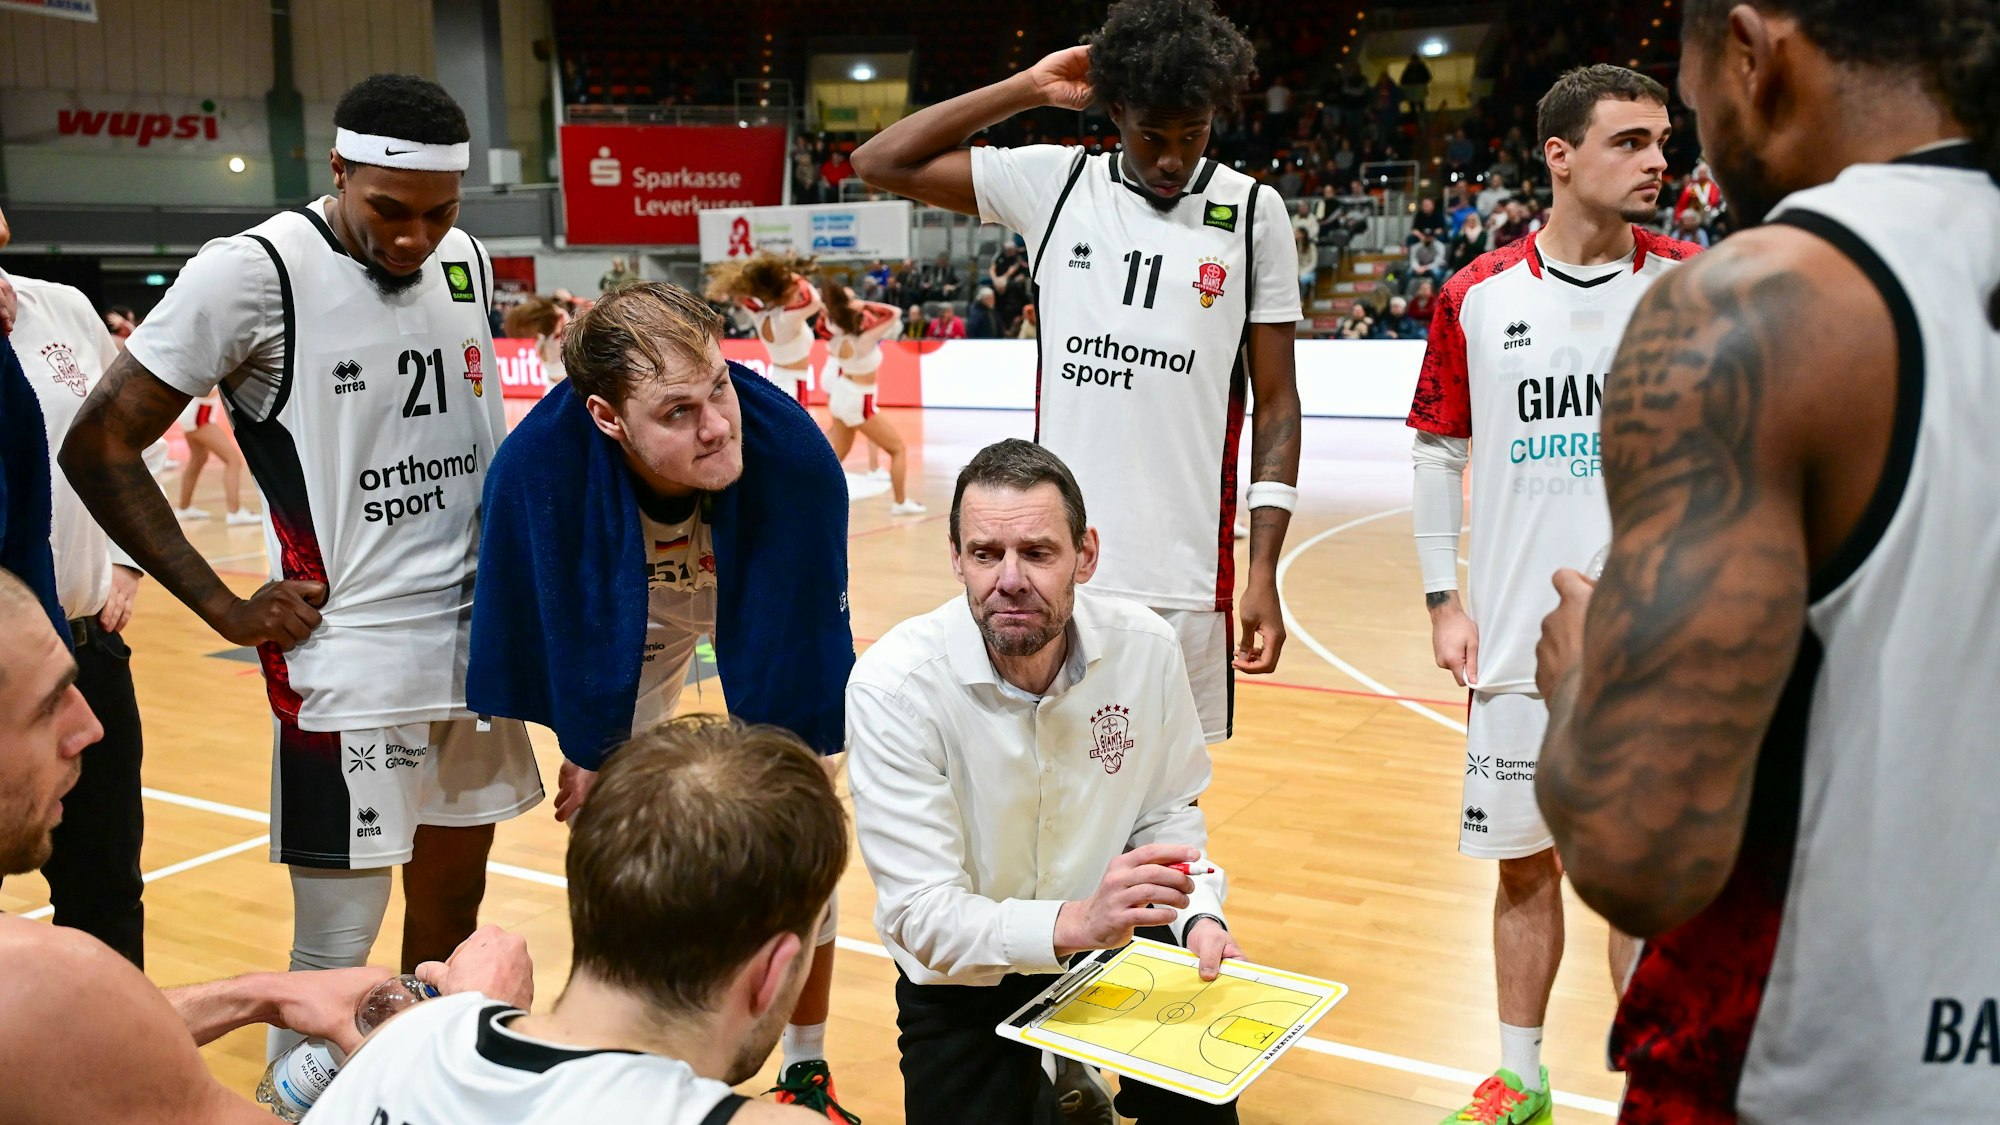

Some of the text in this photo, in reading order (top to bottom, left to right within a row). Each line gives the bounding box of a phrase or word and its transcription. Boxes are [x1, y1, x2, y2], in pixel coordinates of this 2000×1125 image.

[57, 99, 218, 147] wupsi
[632, 167, 742, 192] Sparkasse
[1068, 258, 1091, 270] errea
[1122, 249, 1163, 310] 11
[1066, 333, 1196, 375] orthomol
[1503, 337, 1532, 350] errea
[334, 380, 366, 395] errea
[398, 348, 447, 418] 21
[1061, 362, 1134, 390] sport
[359, 443, 479, 491] orthomol
[363, 485, 446, 526] sport
[1495, 758, 1538, 769] Barme
[1495, 770, 1535, 781] Gotha
[1463, 821, 1488, 834] errea
[1921, 997, 2000, 1065] BA
[301, 1063, 325, 1092] WALDQU
